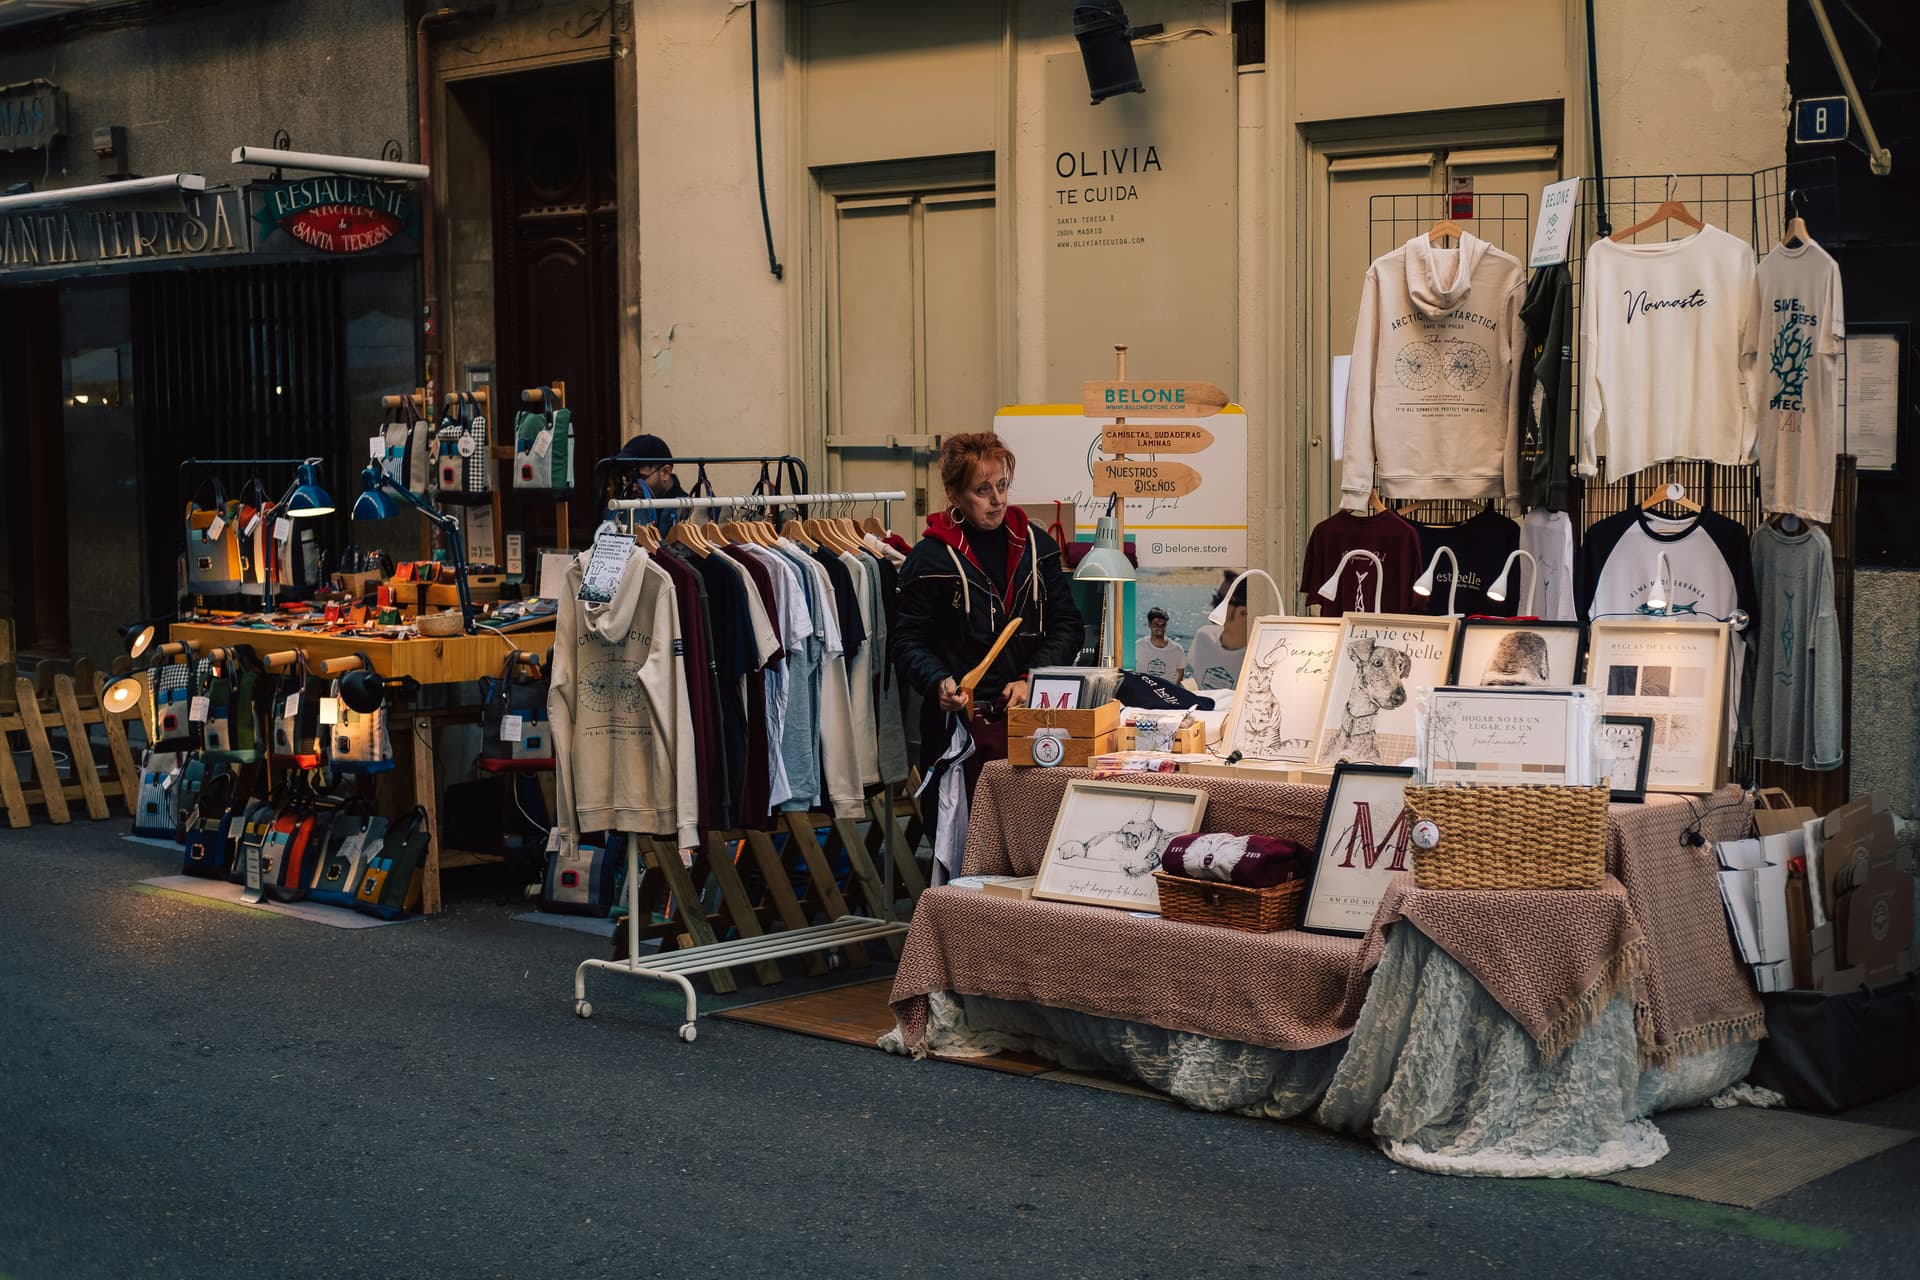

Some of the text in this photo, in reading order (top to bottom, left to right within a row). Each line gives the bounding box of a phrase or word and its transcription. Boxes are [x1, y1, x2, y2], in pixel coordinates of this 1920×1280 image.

[1816, 107, 1827, 134] 8
[1055, 145, 1163, 179] OLIVIA
[275, 178, 404, 216] RESTAURANTE
[1055, 185, 1139, 205] TE CUIDA
[1545, 188, 1571, 208] BELONE
[0, 192, 235, 264] ANTA TERESA
[1057, 217, 1078, 225] SANTA
[1081, 215, 1107, 224] TERESA
[291, 220, 394, 252] SANTA TERESA
[1077, 227, 1103, 236] MADRID
[1057, 237, 1145, 248] WWW.OLIVIATECUIDA.COM
[1624, 288, 1708, 324] Namaste
[1447, 309, 1498, 332] NTARCTICA
[1104, 389, 1185, 403] BELONE
[1106, 431, 1201, 440] CAMISETAS, SUDADERAS
[1106, 466, 1158, 479] NUESTROS
[1135, 479, 1176, 494] DISEÑOS
[1165, 542, 1228, 554] belone.store
[1436, 572, 1453, 583] est
[1630, 584, 1647, 598] ALMA
[1349, 624, 1425, 642] La vie est
[1404, 643, 1443, 660] belle
[1141, 675, 1158, 687] est
[1039, 692, 1073, 709] M
[1462, 714, 1494, 722] HOGAR
[1337, 801, 1409, 872] M
[1090, 884, 1113, 898] happy
